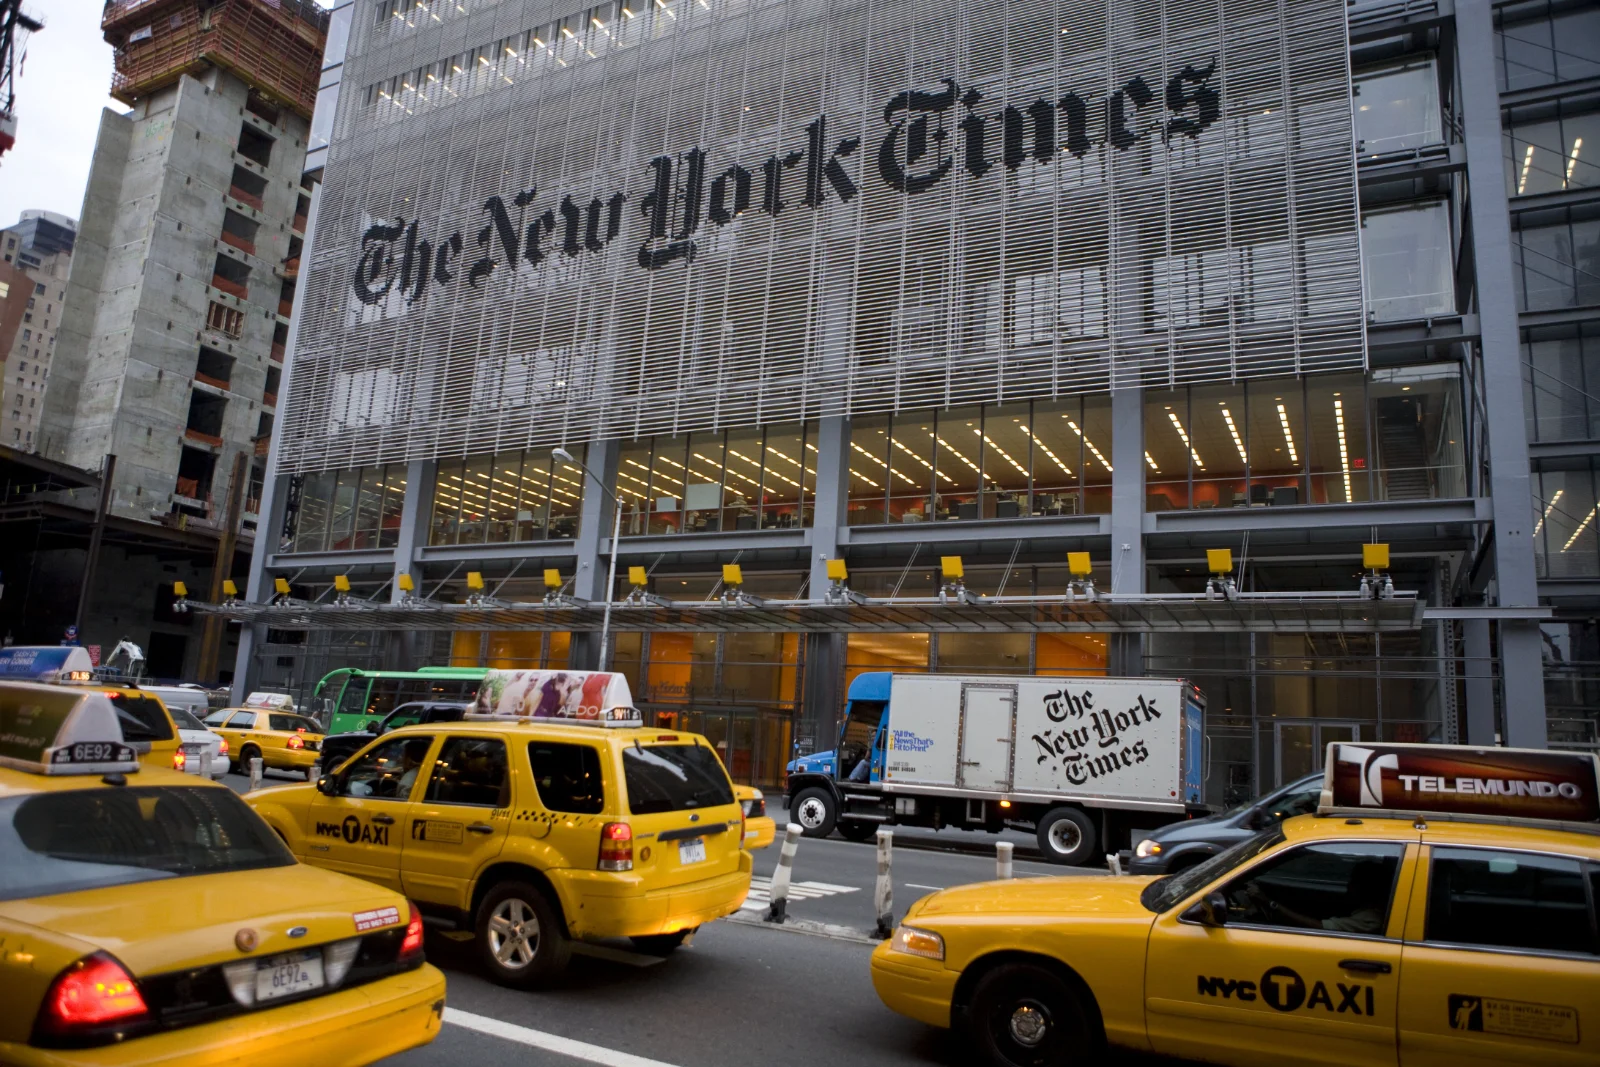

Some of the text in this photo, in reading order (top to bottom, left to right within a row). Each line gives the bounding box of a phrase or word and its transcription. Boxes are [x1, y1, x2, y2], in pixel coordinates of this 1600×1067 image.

[354, 57, 1221, 306] The New York Times
[557, 705, 599, 718] ALDO
[1043, 689, 1096, 722] The
[894, 737, 914, 745] News
[1031, 694, 1162, 765] New York
[74, 743, 112, 760] 6E92
[1062, 739, 1149, 785] Times
[1398, 774, 1583, 799] TELEMUNDO
[316, 815, 389, 846] NYC TAXI
[272, 963, 301, 987] 6E92
[1197, 966, 1375, 1016] NYC TAXI
